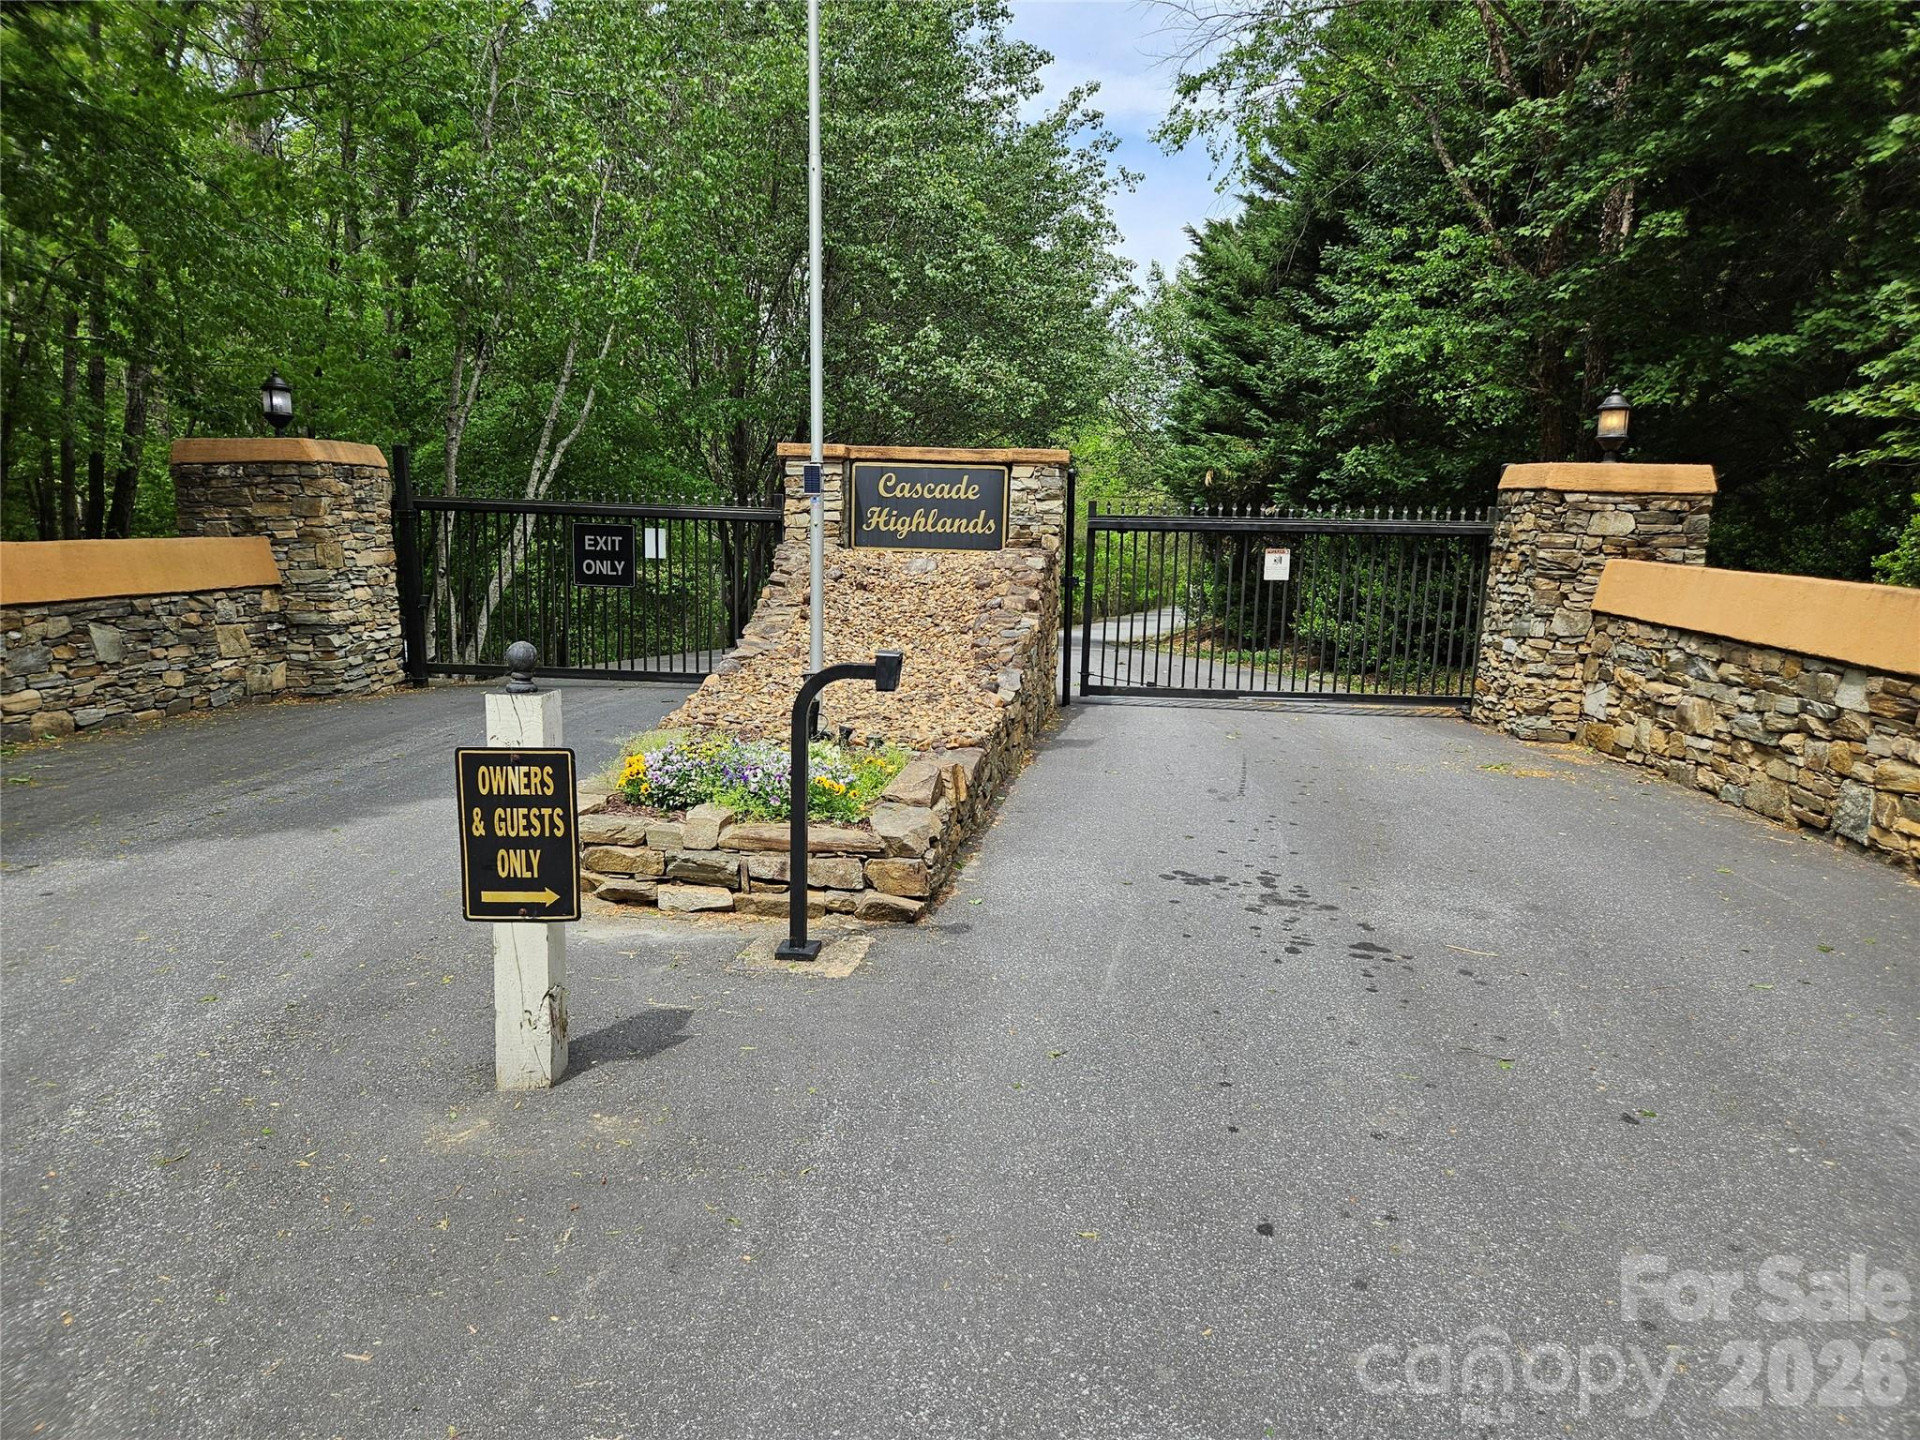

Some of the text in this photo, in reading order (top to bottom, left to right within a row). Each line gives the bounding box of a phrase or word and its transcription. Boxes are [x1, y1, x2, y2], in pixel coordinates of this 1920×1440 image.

[878, 472, 981, 500] Cascade
[862, 506, 996, 539] Highlands
[584, 535, 622, 551] EXIT
[582, 559, 625, 575] ONLY
[477, 765, 554, 796] OWNERS
[471, 807, 565, 837] & GUESTS
[496, 848, 541, 879] ONLY
